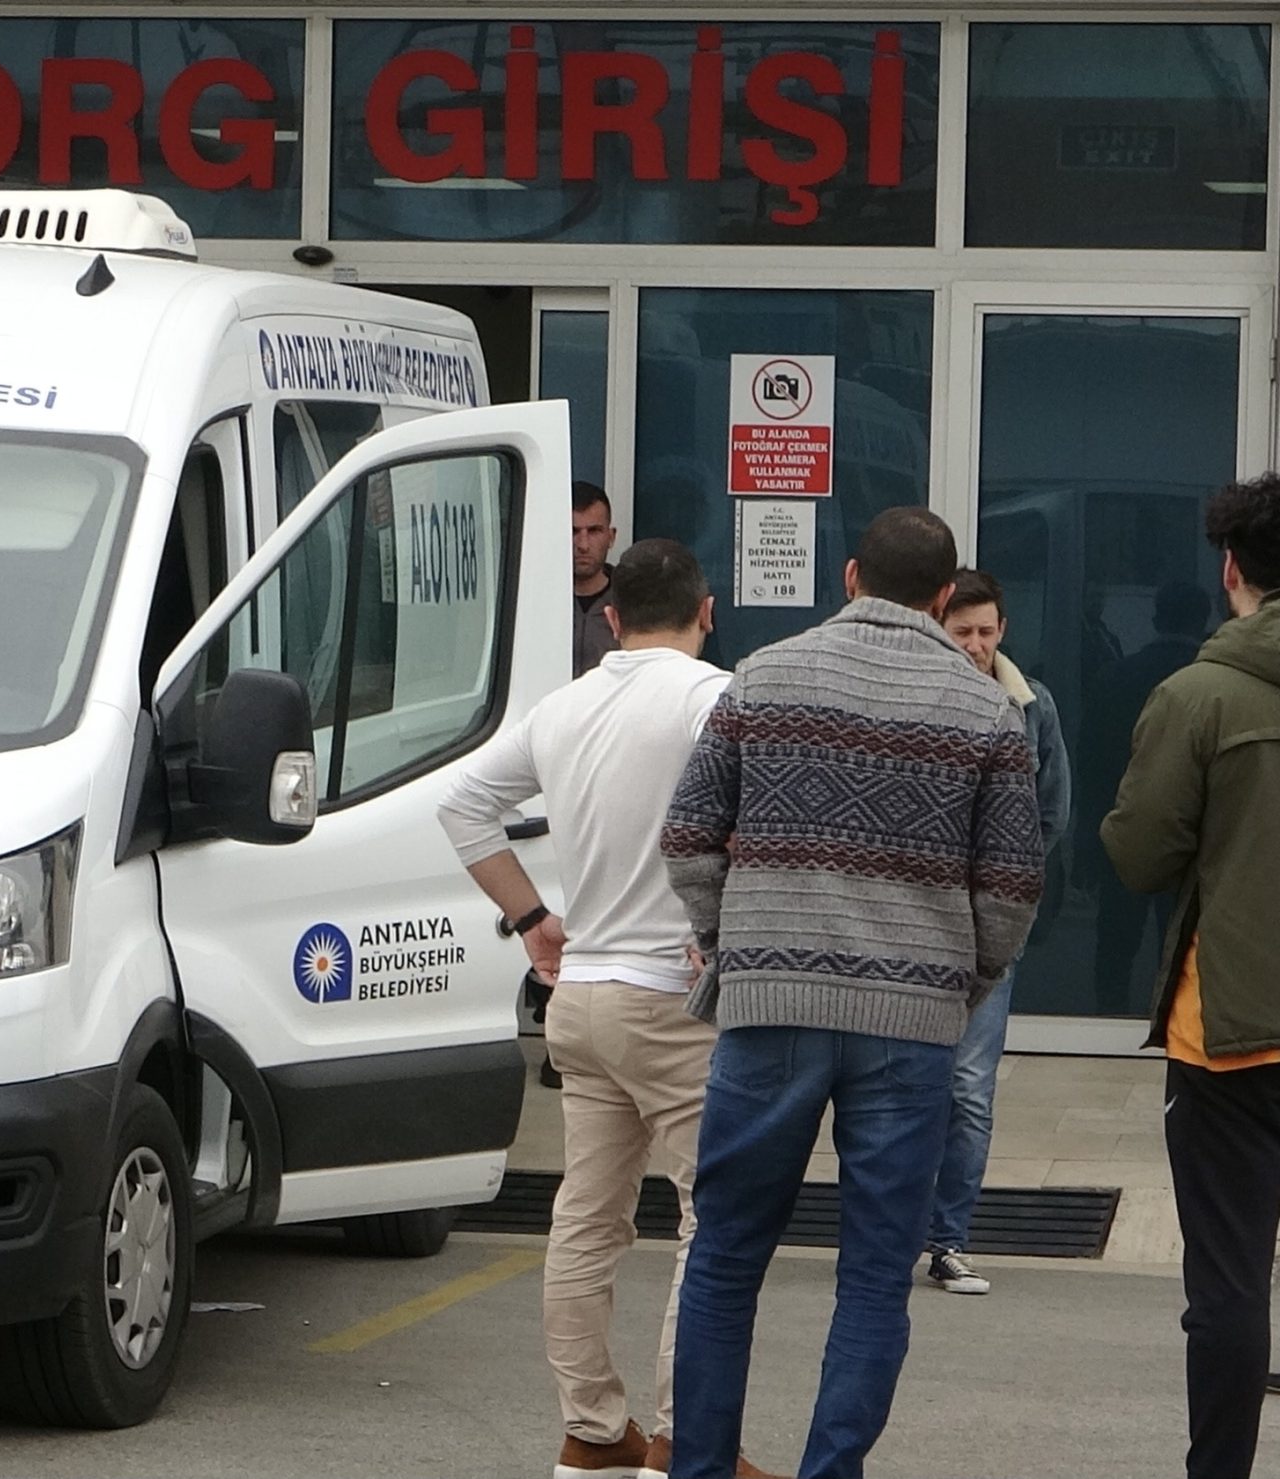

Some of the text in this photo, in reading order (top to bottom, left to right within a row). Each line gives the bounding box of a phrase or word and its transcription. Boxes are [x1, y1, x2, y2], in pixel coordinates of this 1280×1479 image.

[365, 26, 906, 227] GİRİŞİ
[1084, 149, 1155, 164] EXIT
[276, 333, 342, 390] ANTALYA
[751, 429, 810, 440] BU ALANDA
[733, 440, 828, 453] FOTOĞRAF ÇEKMEK
[745, 454, 816, 465] VEYA KAMERA
[749, 466, 811, 477] KULLANMAK
[755, 478, 805, 489] YASAKTIR
[759, 537, 796, 546] CENAZE
[411, 501, 443, 605] ALO
[452, 503, 478, 602] 188
[748, 547, 807, 557] DEFİN-NAKİL
[750, 558, 806, 568] HİZMETLERİ
[763, 571, 792, 580] HATTI
[774, 584, 796, 596] 188
[359, 916, 455, 948] ANTALYA
[360, 942, 466, 974] BÜYÜKŞEHİR
[358, 969, 450, 1001] BELEDİYESİ
